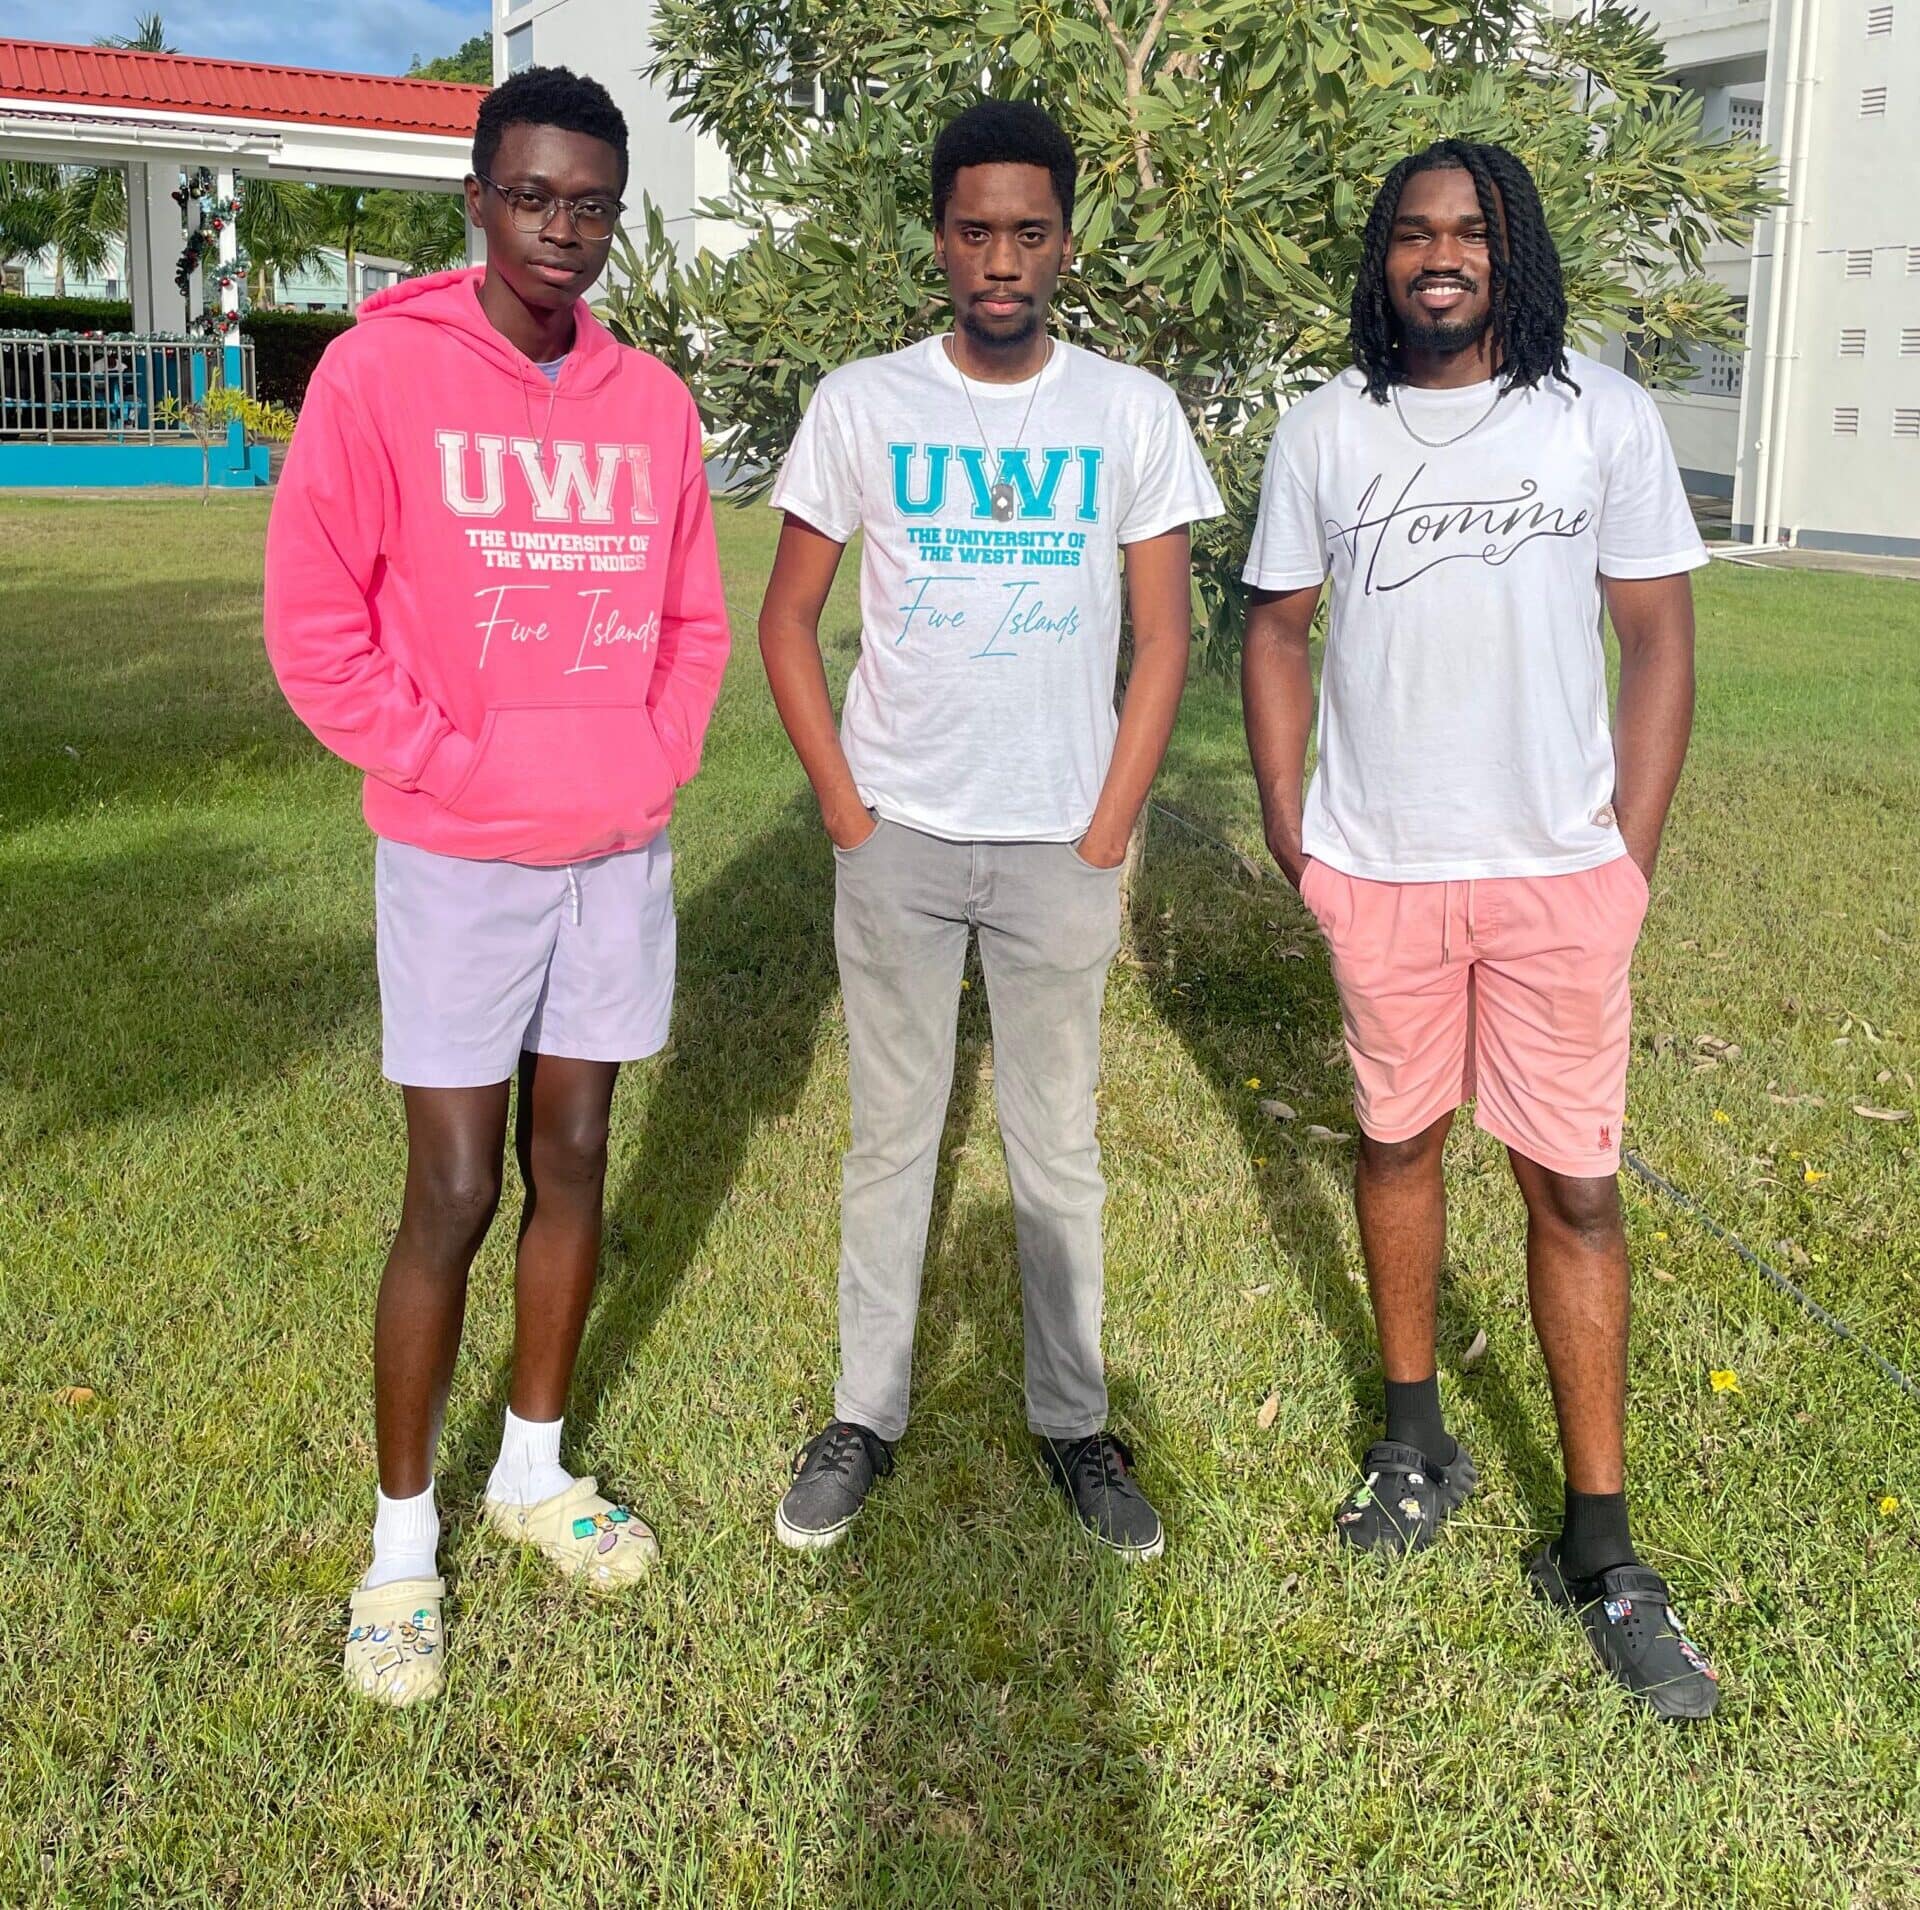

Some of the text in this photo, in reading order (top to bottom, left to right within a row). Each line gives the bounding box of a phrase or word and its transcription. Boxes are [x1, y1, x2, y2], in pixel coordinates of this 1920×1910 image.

[435, 429, 659, 524] UWI
[888, 442, 1104, 523] UWI
[465, 529, 650, 552] THE UNIVERSITY OF
[482, 550, 646, 572] THE WEST INDIES
[906, 528, 1086, 549] THE UNIVERSITY OF
[919, 546, 1080, 566] THE WEST INDIES
[1325, 462, 1593, 595] Homme
[473, 584, 659, 674] Five Islands
[896, 576, 1079, 659] Five Islands
